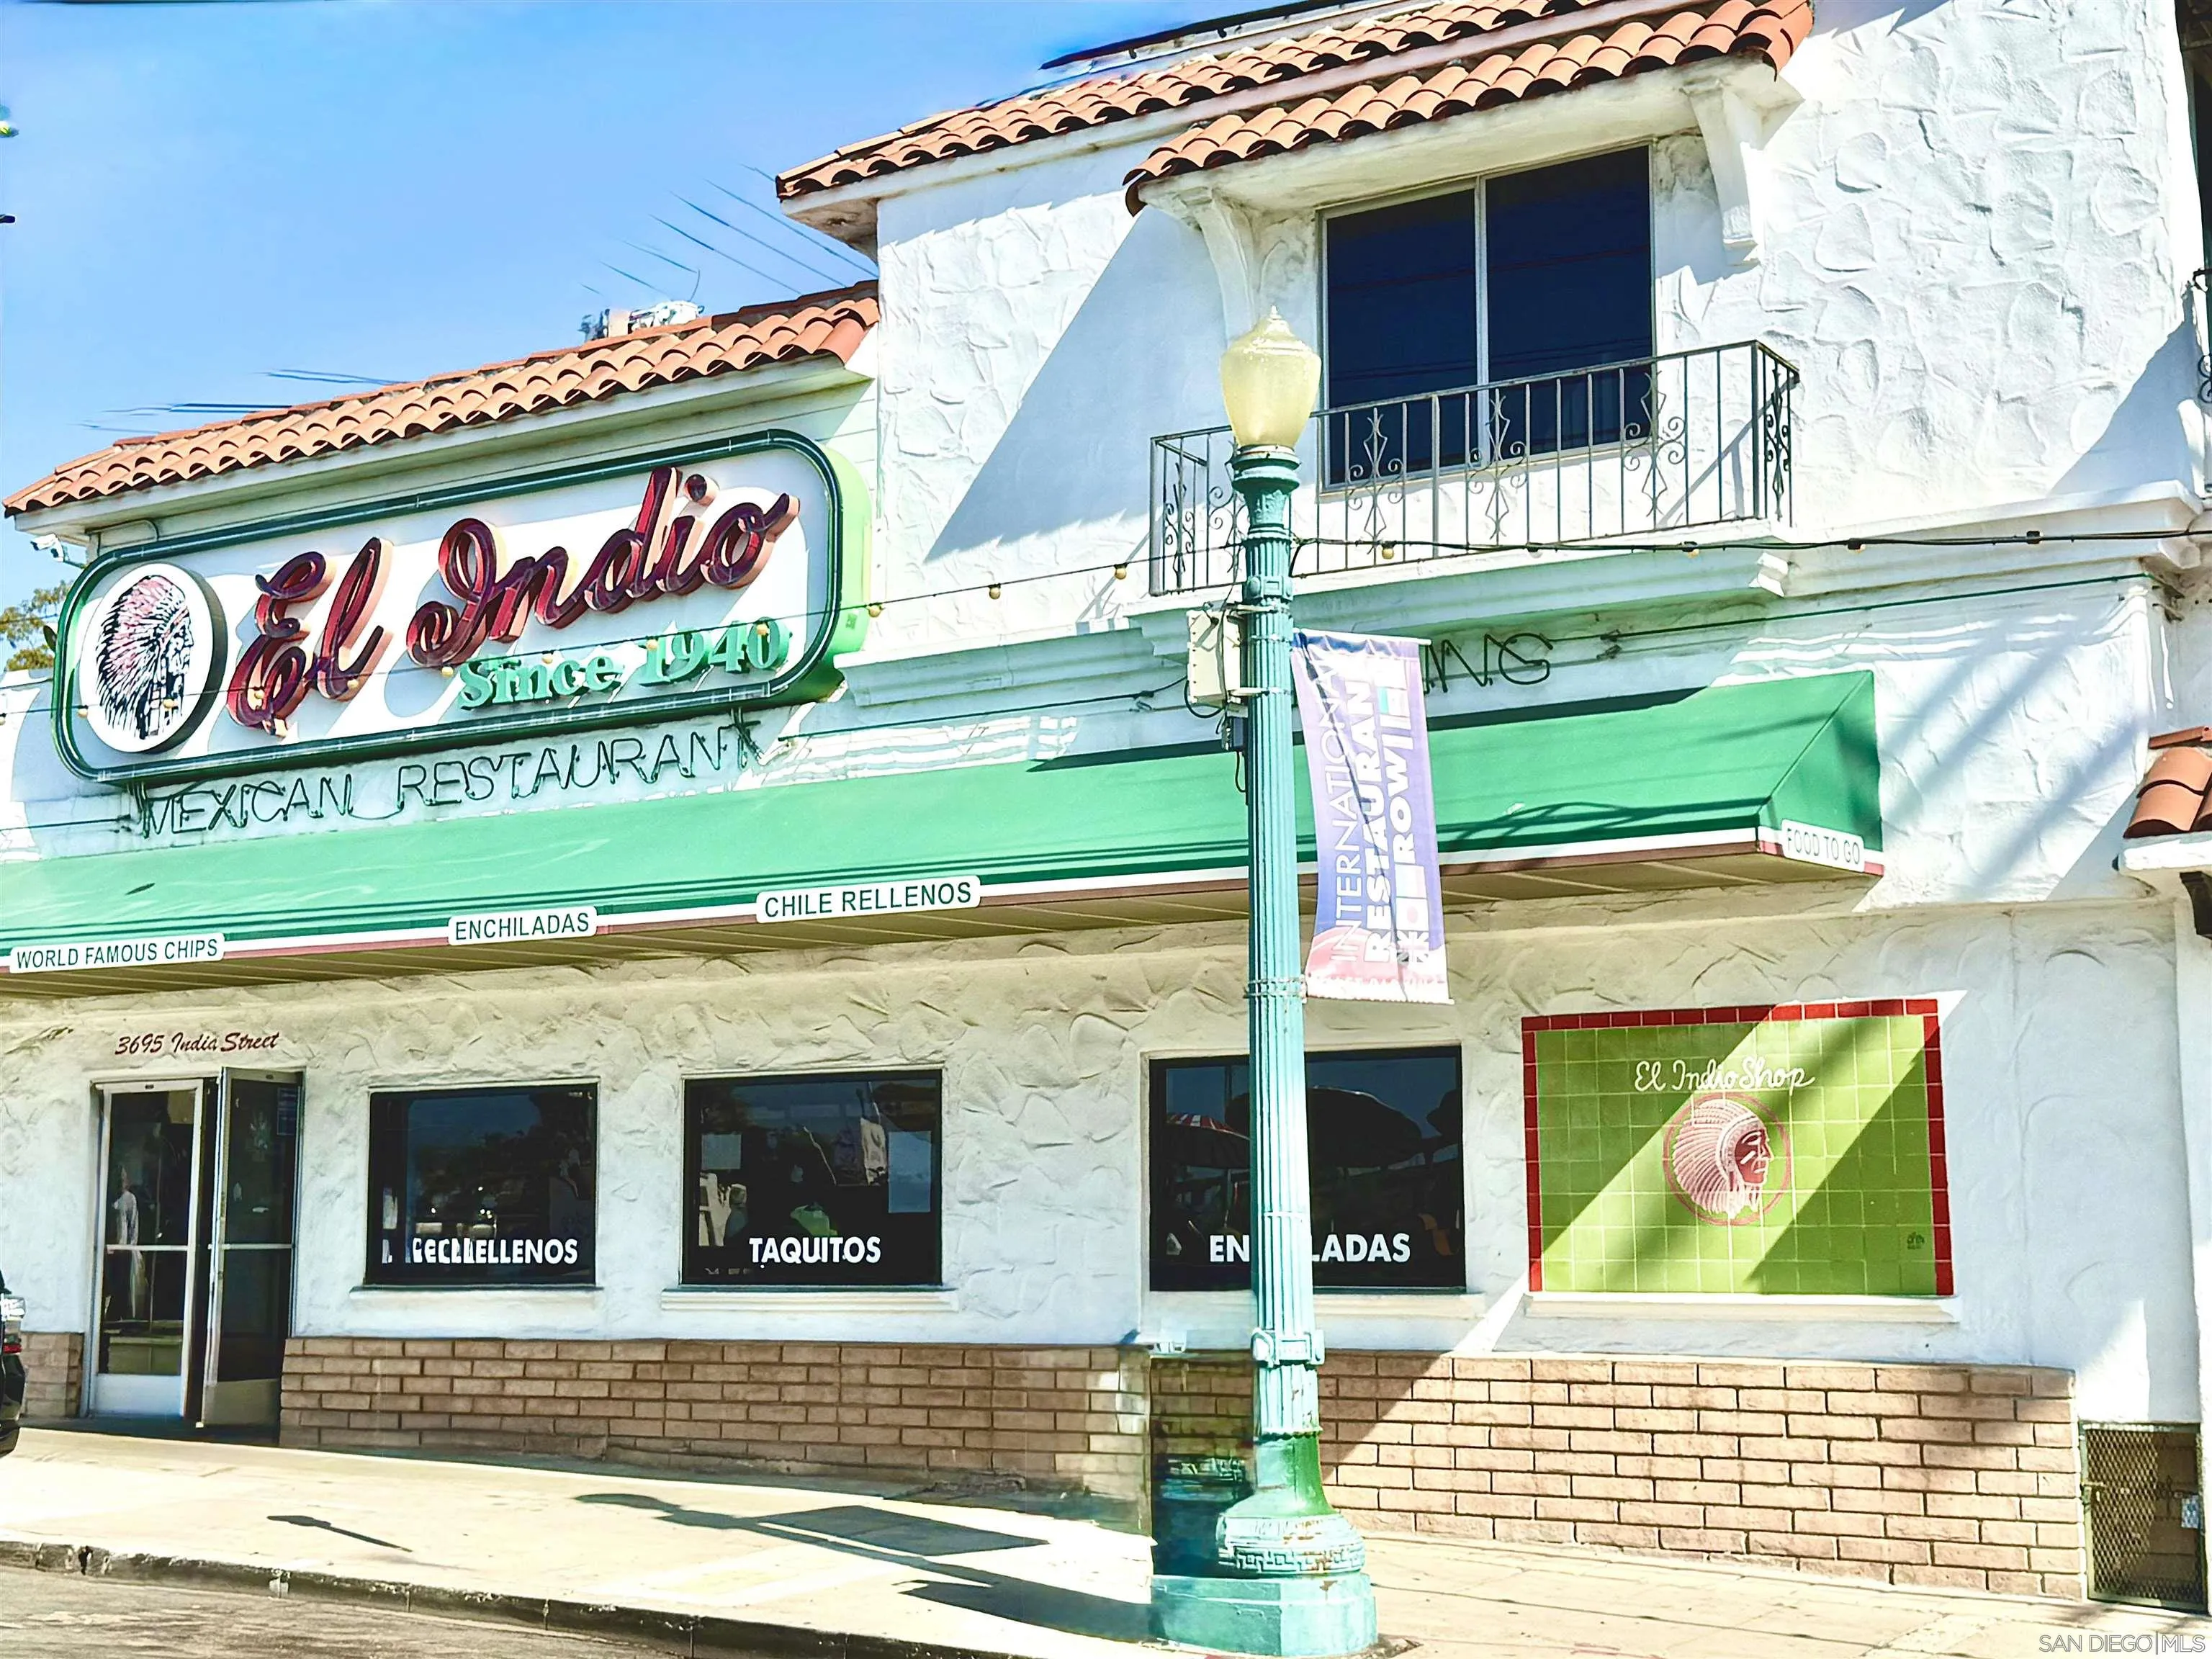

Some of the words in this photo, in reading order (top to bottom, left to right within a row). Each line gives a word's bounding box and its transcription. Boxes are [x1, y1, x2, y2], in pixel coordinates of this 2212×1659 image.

[226, 536, 395, 735] El
[407, 467, 799, 667] Indio
[459, 652, 624, 711] Since
[639, 617, 791, 686] 1940
[143, 773, 353, 837] MEXICAN
[397, 721, 761, 809] RESTAURANT
[1312, 661, 1363, 962] INTERNATIONA
[1344, 675, 1395, 963] RESTAURAN
[1787, 827, 1820, 856] FOOD
[1823, 836, 1839, 860] TO
[1843, 840, 1860, 864] GO
[765, 892, 832, 917] CHILE
[842, 881, 971, 912] RELLENOS
[456, 912, 589, 940] ENCHILADAS
[17, 948, 78, 968] WORLD
[85, 943, 157, 964] FAMOUS
[164, 938, 217, 960] CHIPS
[114, 1033, 165, 1055] 3695
[171, 1031, 217, 1053] India
[220, 1031, 280, 1052] Street
[1635, 1061, 1666, 1092] El
[1672, 1058, 1740, 1091] Indio
[1739, 1056, 1815, 1096] Shop
[749, 1236, 881, 1264] TAQUITOS
